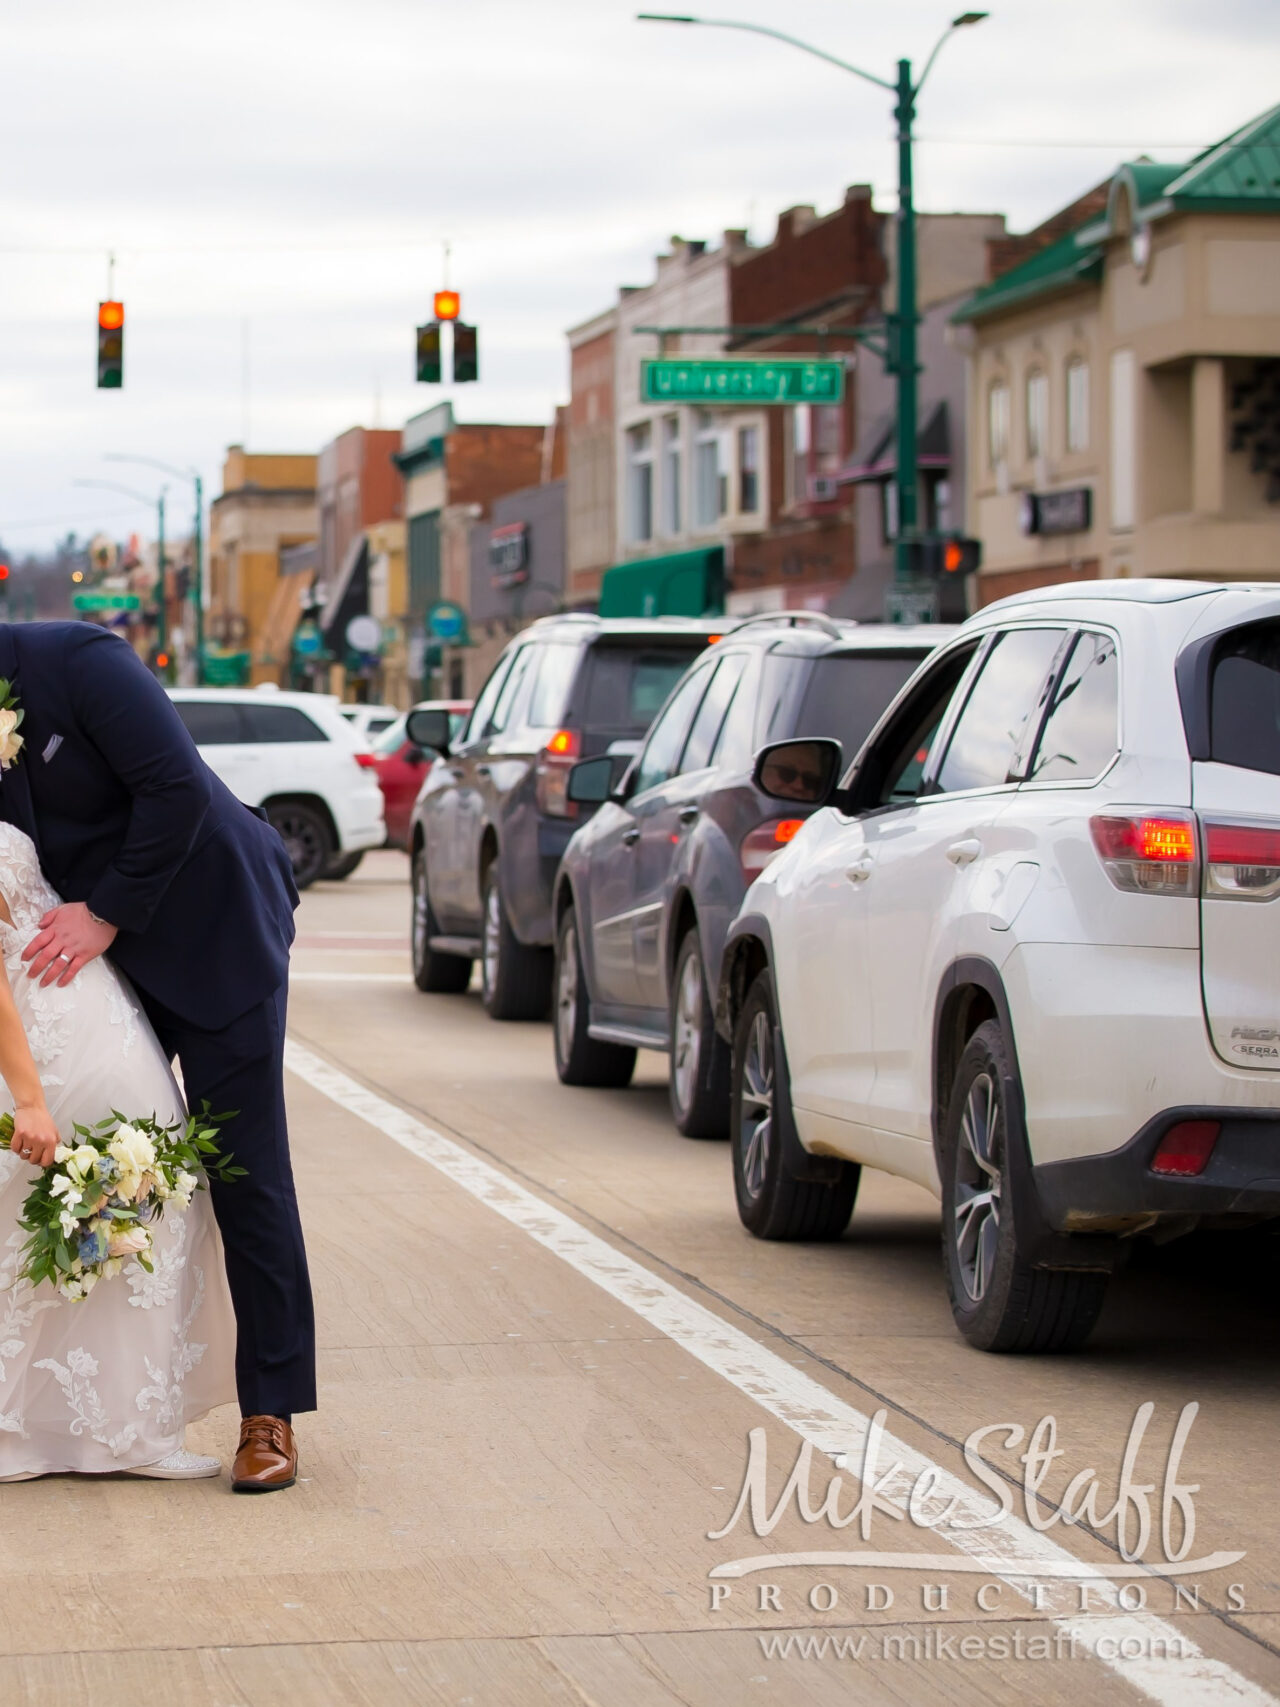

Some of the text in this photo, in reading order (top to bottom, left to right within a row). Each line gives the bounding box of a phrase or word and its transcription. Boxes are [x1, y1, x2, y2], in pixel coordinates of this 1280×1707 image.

[655, 364, 835, 401] University Dr
[1240, 1045, 1278, 1054] SERRA
